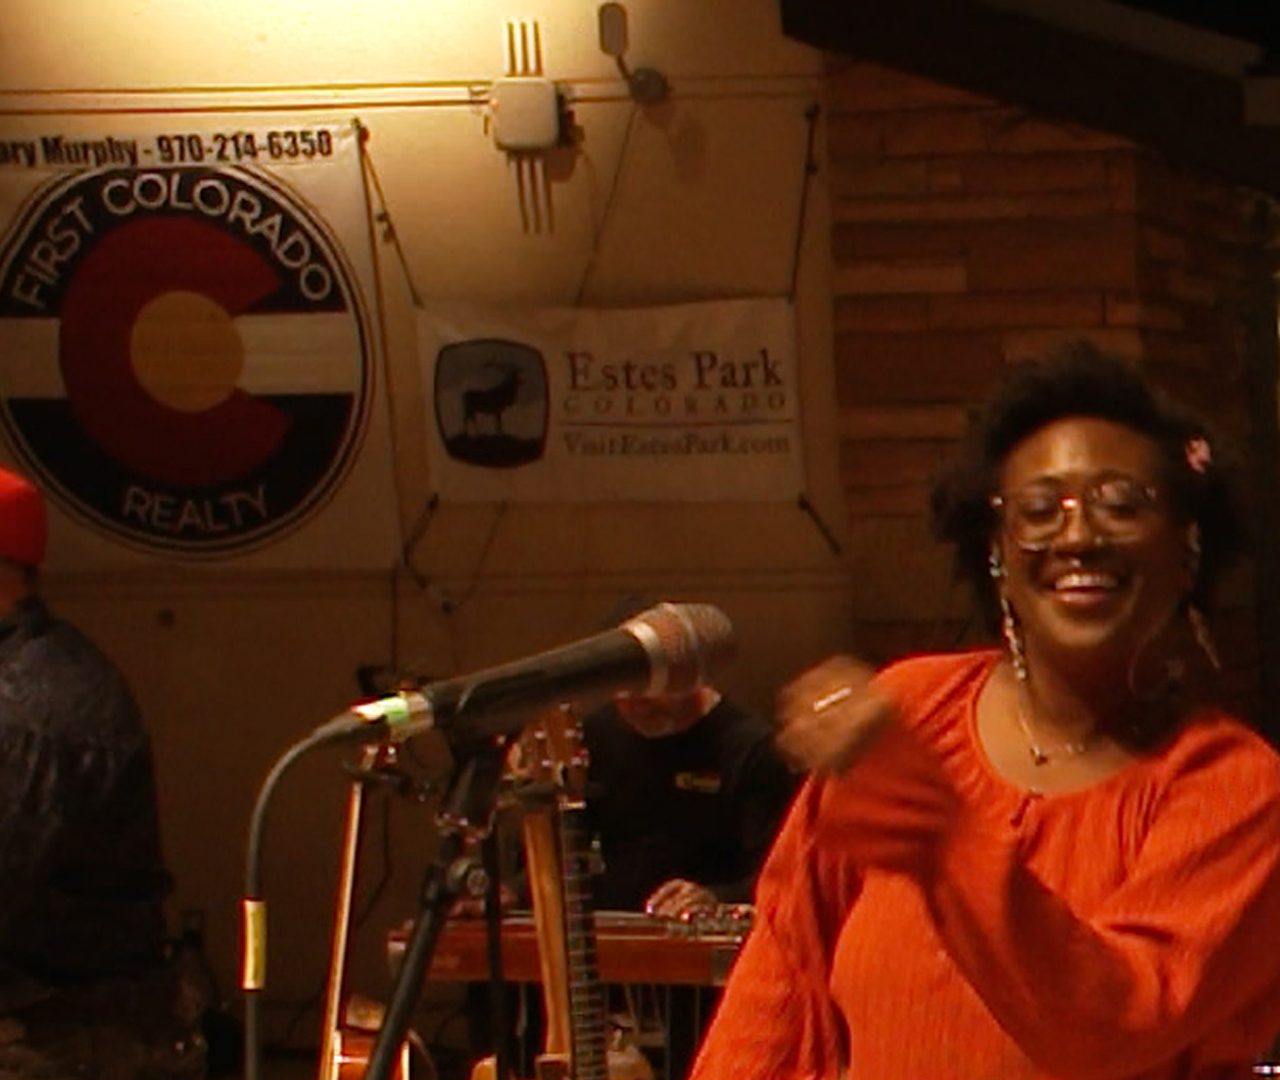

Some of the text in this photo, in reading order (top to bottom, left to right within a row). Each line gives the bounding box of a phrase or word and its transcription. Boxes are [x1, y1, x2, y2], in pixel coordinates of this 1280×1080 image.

[41, 136, 138, 166] Murphy
[156, 130, 333, 164] 970-214-6350
[12, 173, 332, 310] FIRST COLORADO
[566, 348, 783, 391] Estes Park
[564, 393, 785, 414] COLORADO
[565, 433, 788, 456] VisitEstesPark.com
[122, 485, 268, 533] REALTY
